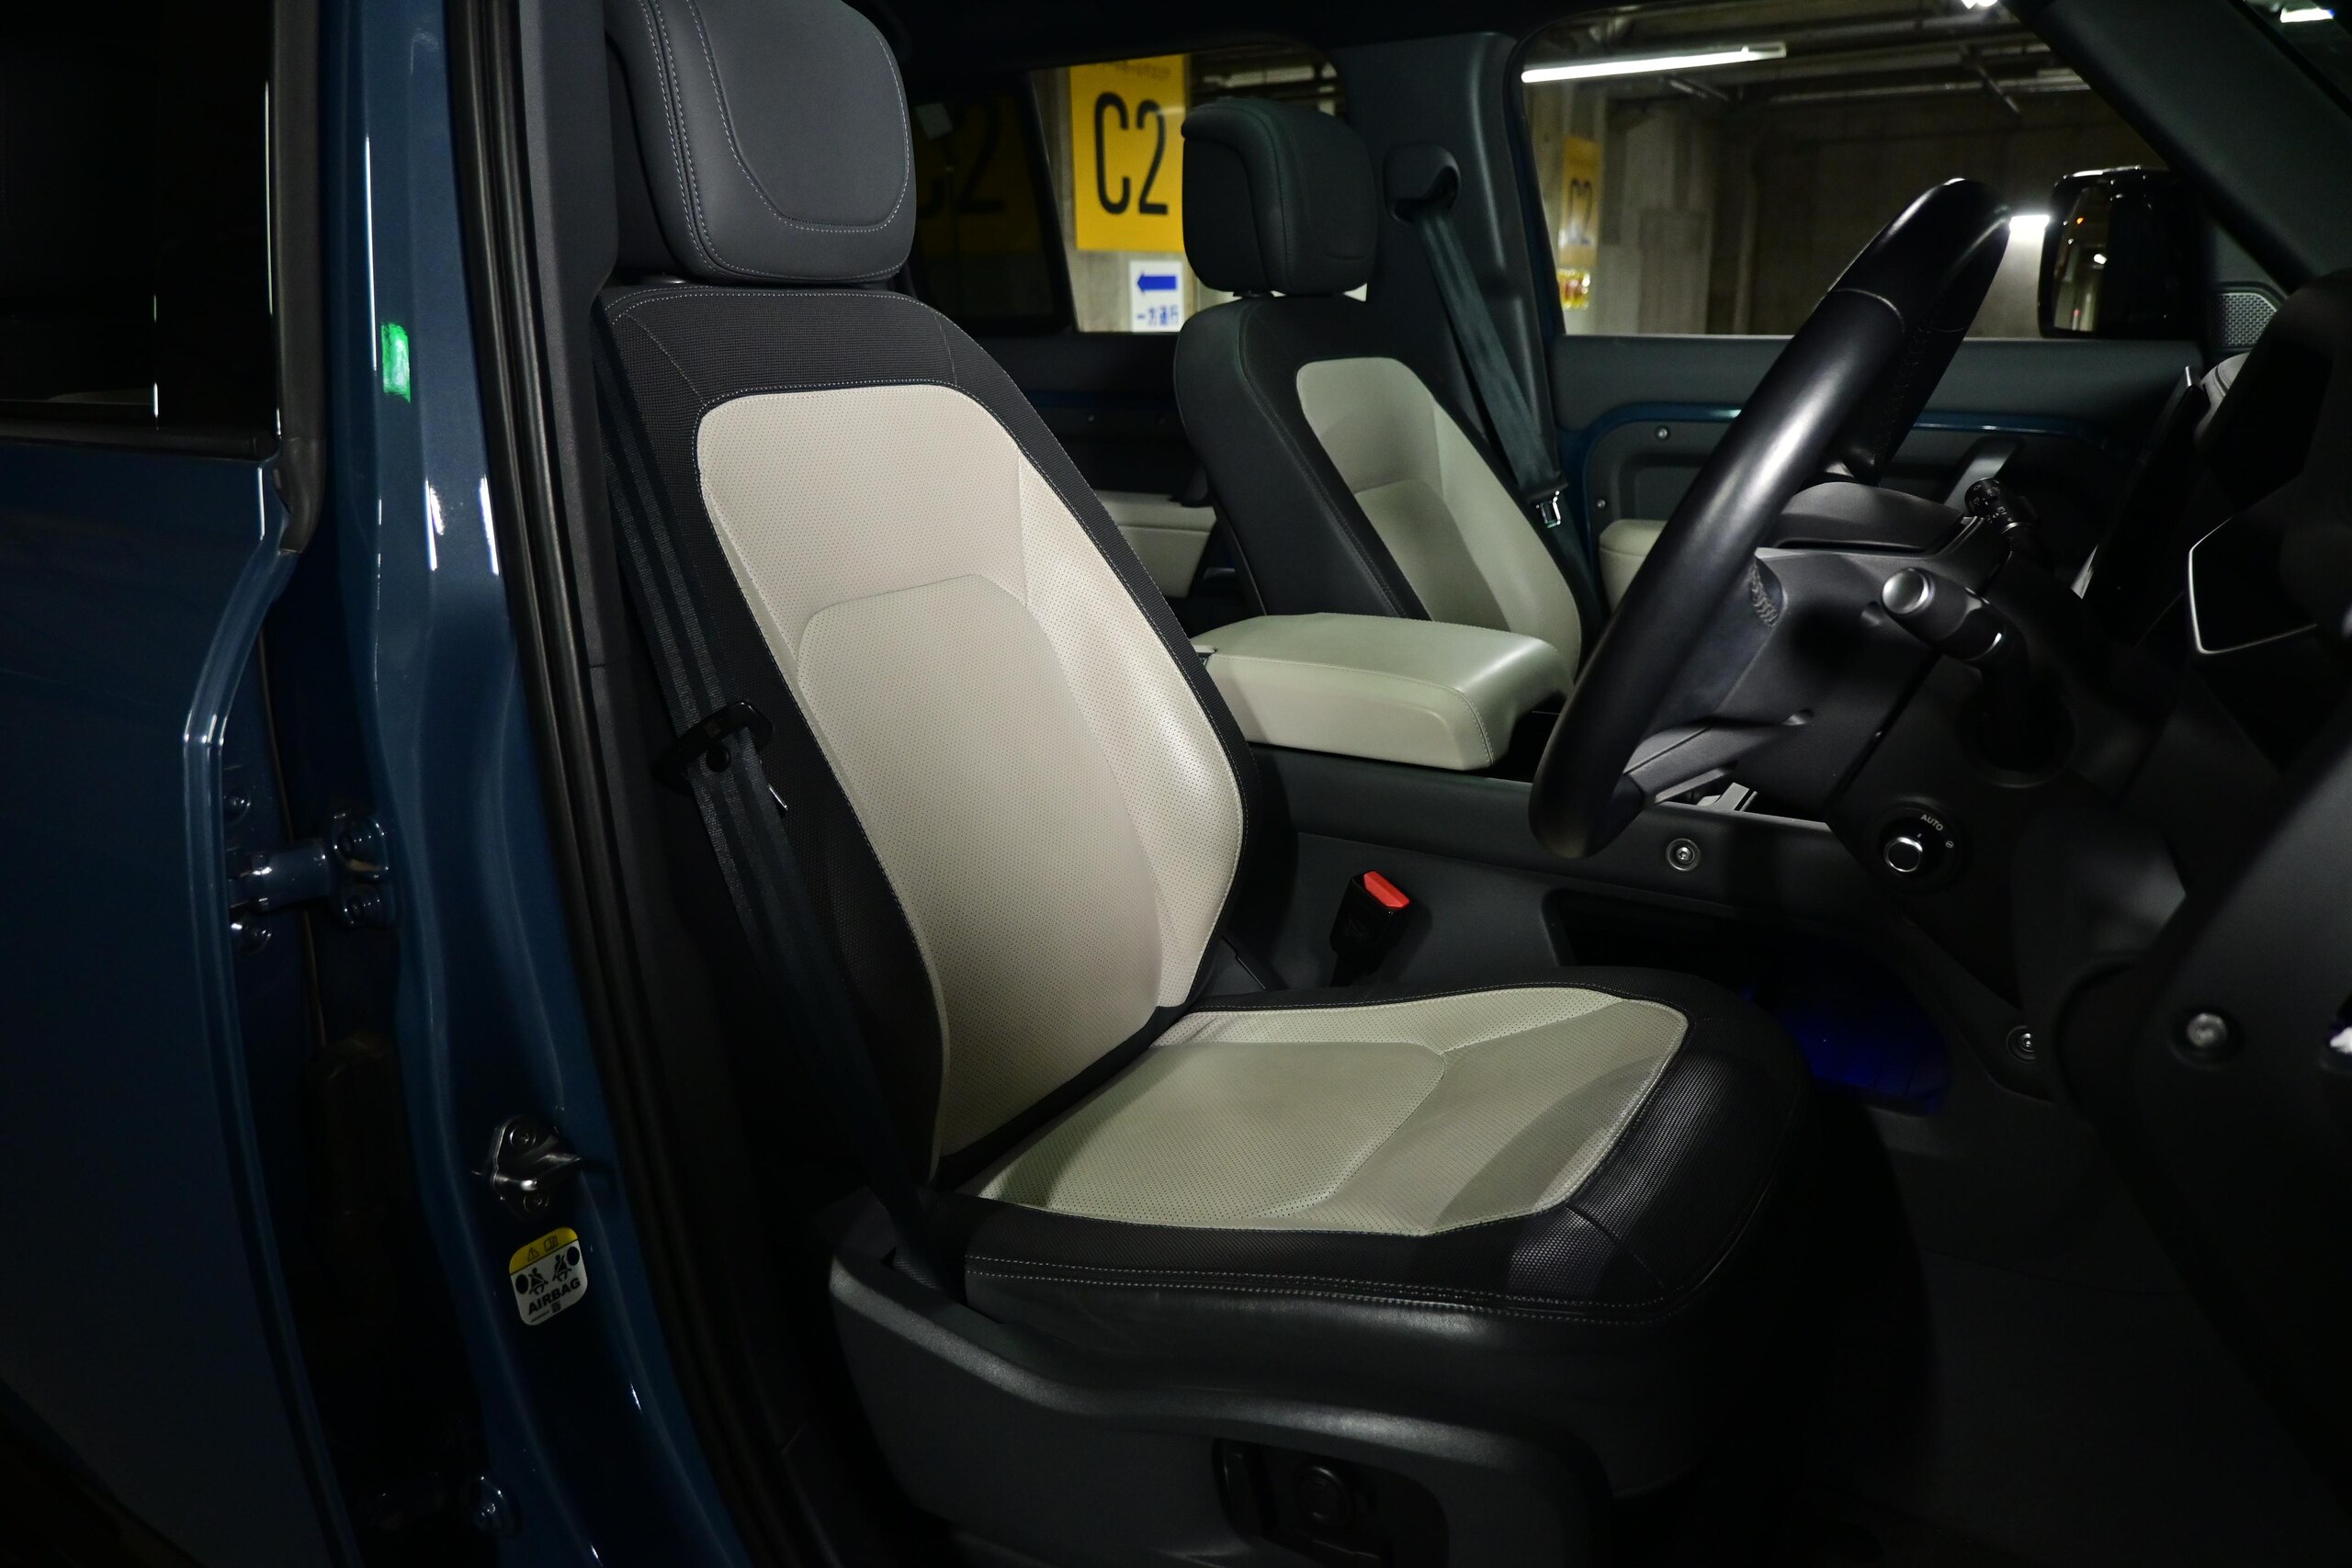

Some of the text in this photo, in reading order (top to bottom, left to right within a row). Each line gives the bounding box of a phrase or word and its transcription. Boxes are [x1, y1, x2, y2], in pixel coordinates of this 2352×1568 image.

[1096, 93, 1168, 215] C2
[1920, 814, 1943, 831] AUTO
[528, 1278, 581, 1315] AIRBAG
